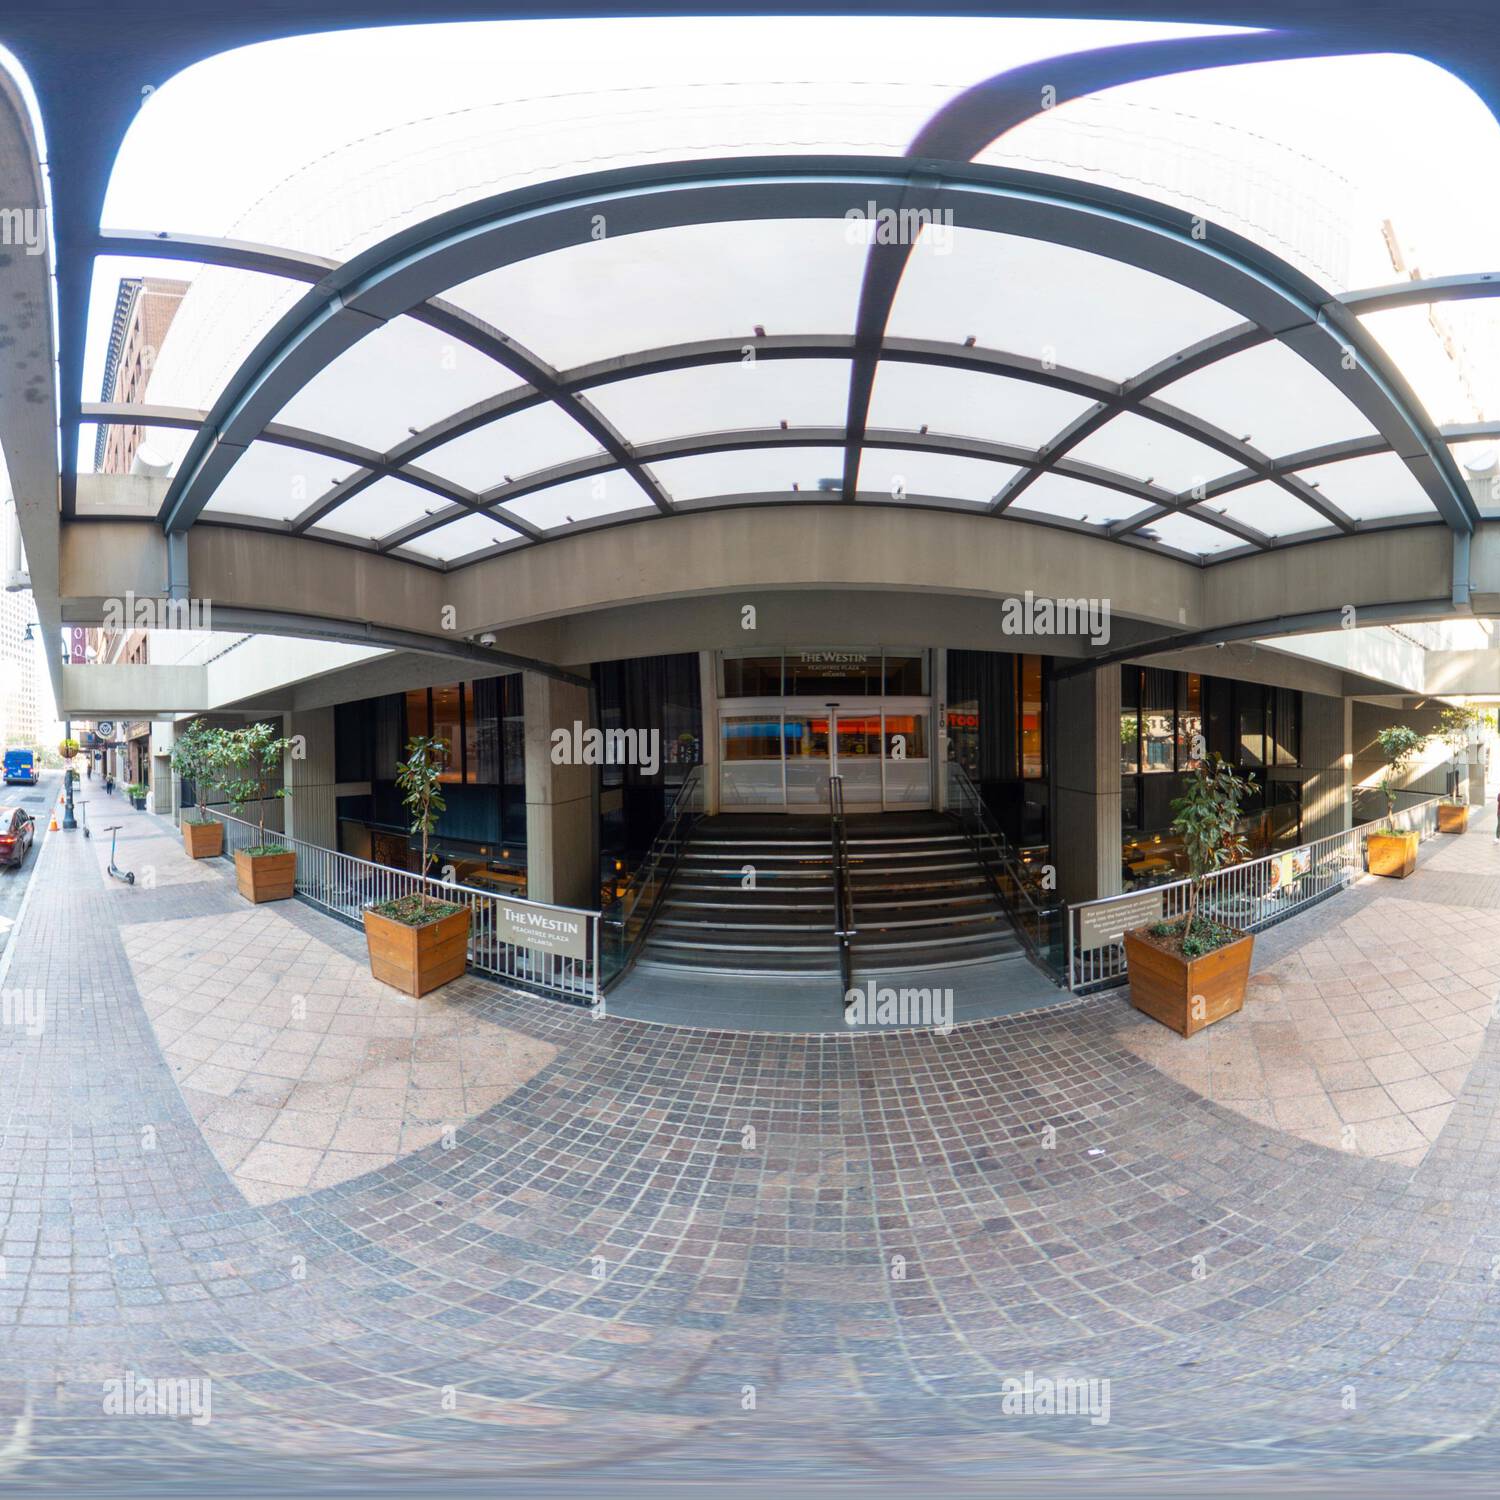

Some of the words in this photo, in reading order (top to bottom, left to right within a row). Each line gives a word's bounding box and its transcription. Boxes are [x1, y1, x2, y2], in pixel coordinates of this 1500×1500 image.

[800, 652, 822, 662] THE
[822, 652, 867, 662] WESTIN
[503, 908, 527, 924] THE
[527, 912, 578, 934] WESTIN
[512, 925, 547, 938] PEACHTREE
[547, 933, 569, 942] PLAZA
[527, 936, 553, 947] ATLANTA
